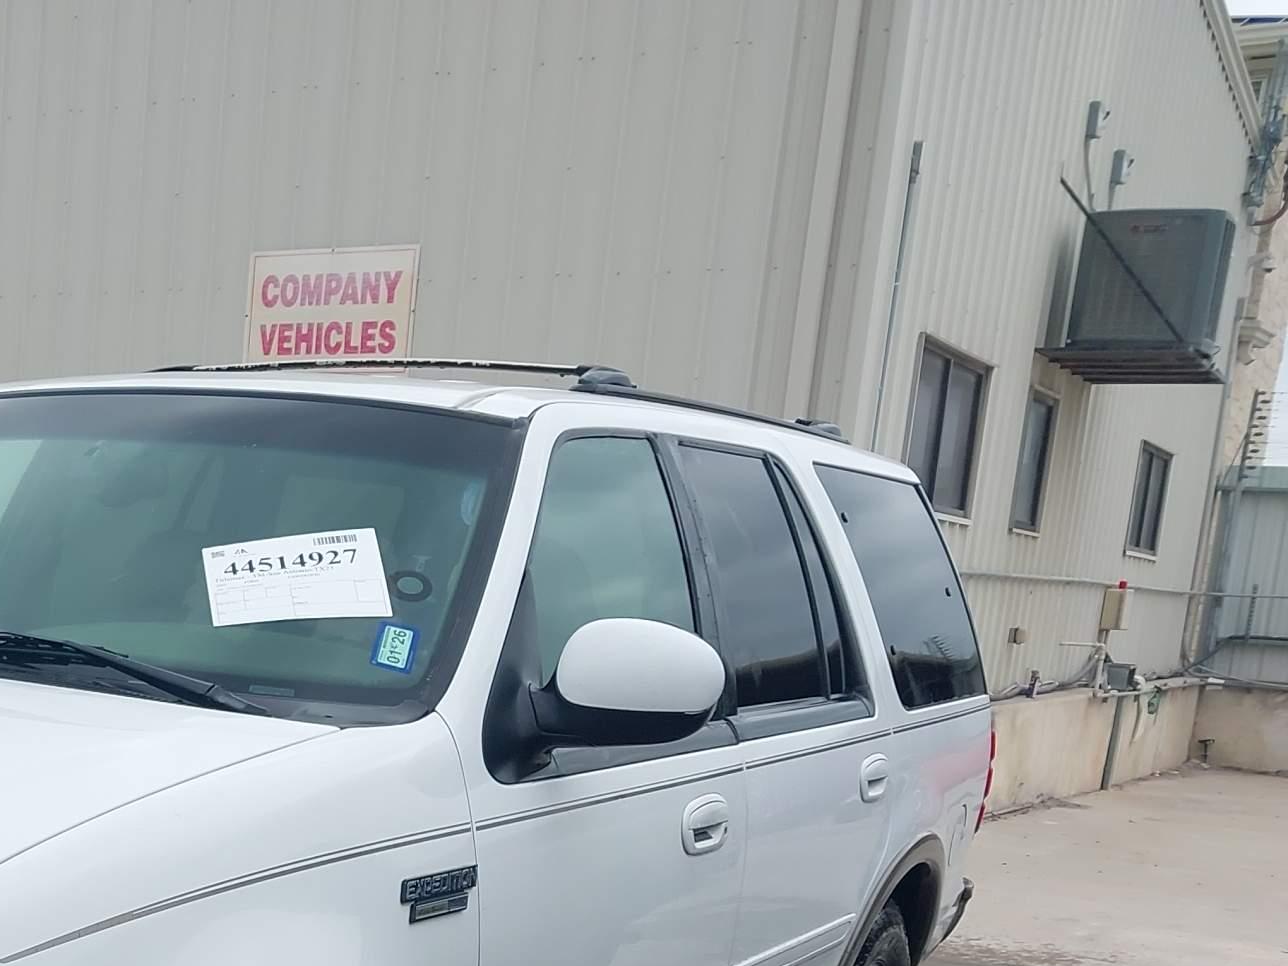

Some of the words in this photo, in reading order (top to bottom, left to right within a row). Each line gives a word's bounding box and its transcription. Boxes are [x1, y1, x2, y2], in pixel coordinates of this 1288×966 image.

[261, 270, 404, 308] COMPANY
[259, 320, 397, 356] VEHICLES
[223, 548, 358, 576] 44514927
